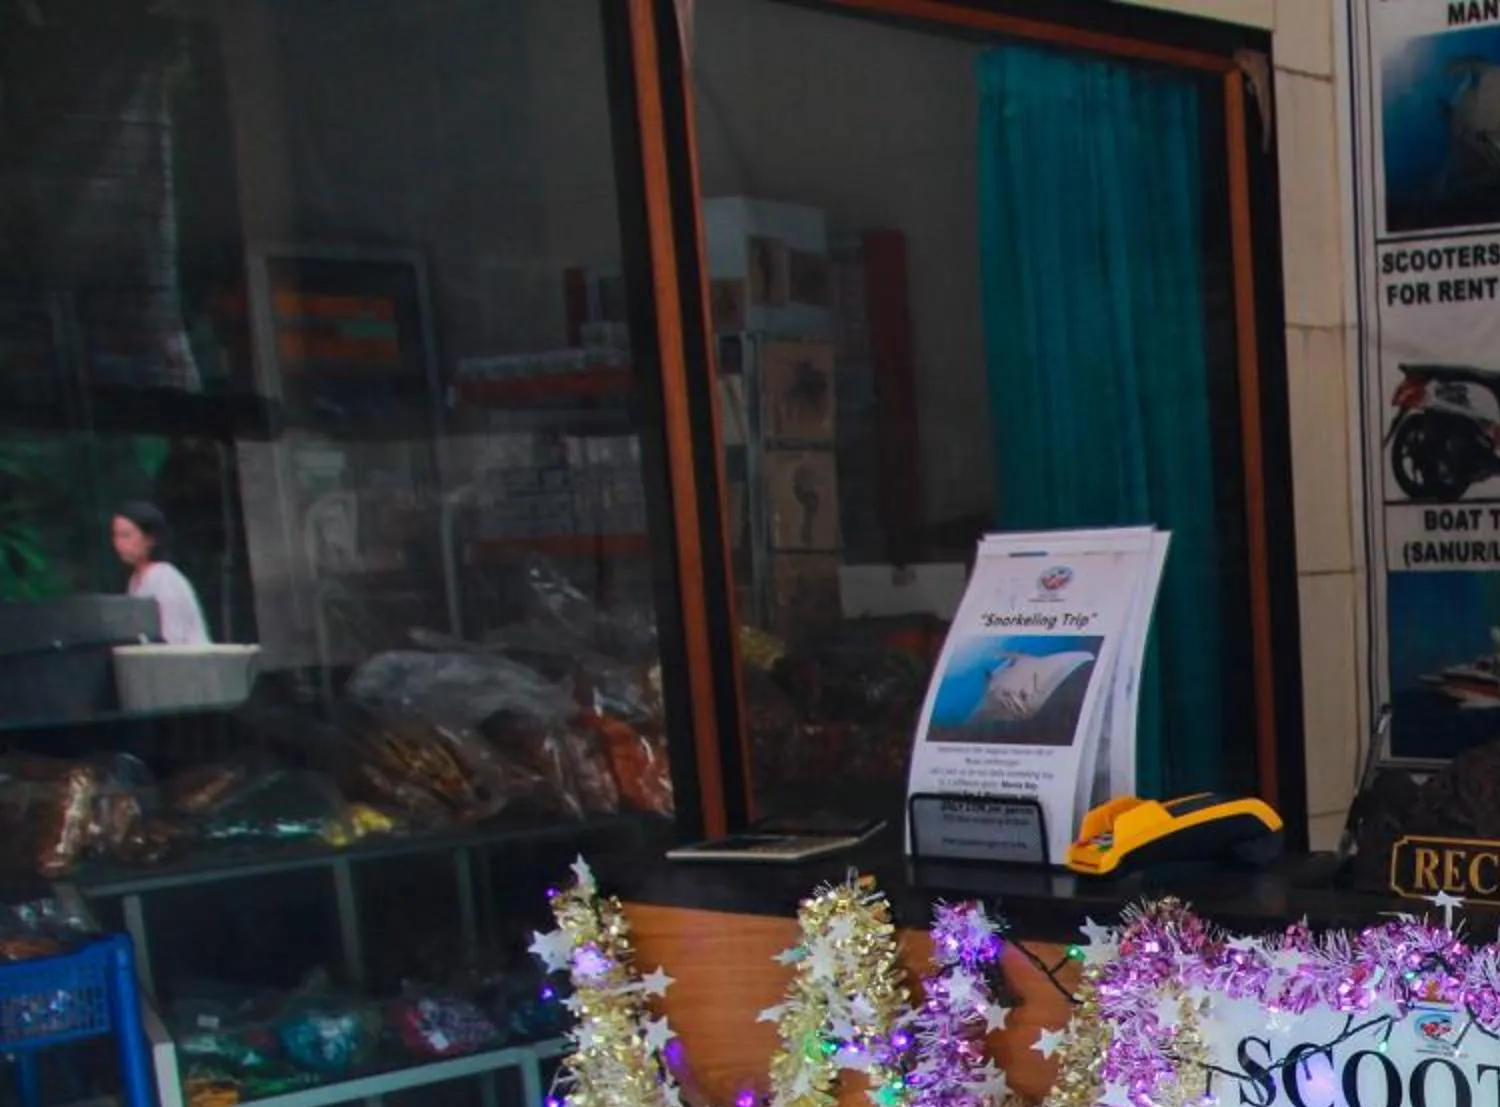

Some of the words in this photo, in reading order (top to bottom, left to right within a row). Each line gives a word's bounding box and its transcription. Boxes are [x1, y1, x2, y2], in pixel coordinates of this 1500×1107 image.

[1386, 285, 1431, 306] FOR
[1438, 278, 1499, 302] RENT
[1423, 508, 1481, 532] BOAT
